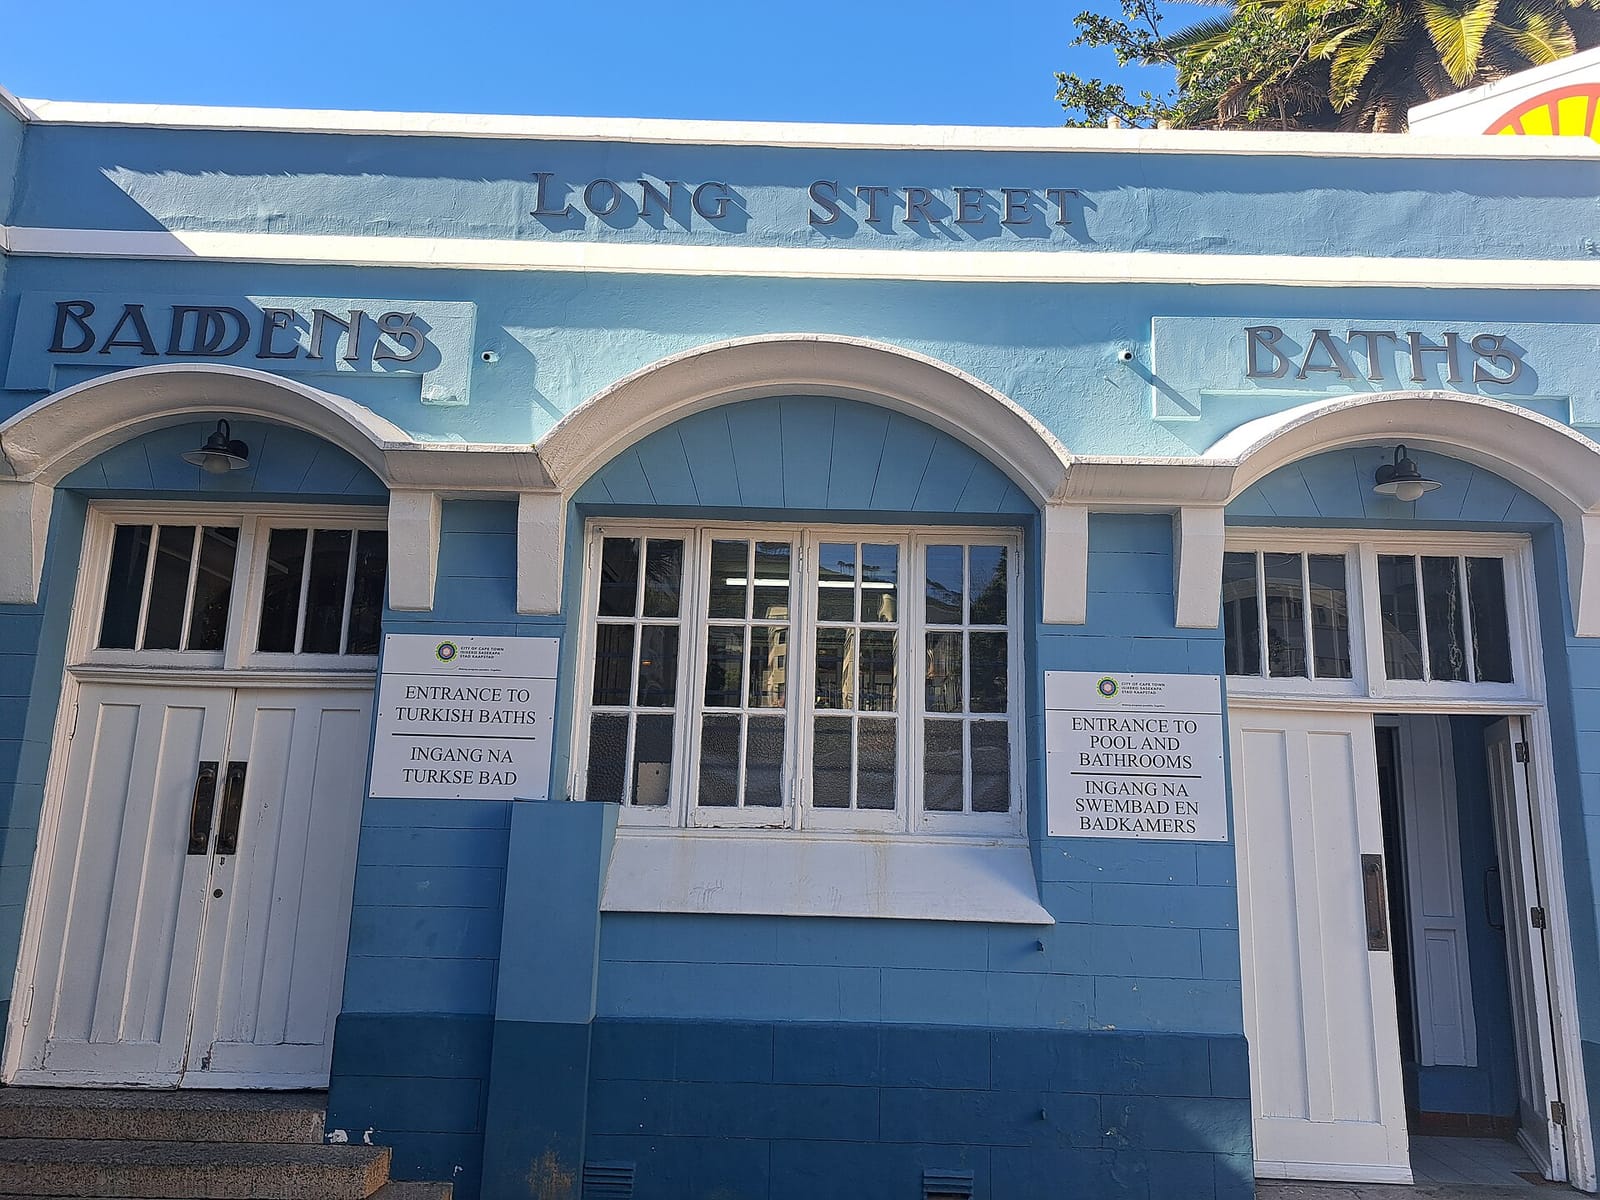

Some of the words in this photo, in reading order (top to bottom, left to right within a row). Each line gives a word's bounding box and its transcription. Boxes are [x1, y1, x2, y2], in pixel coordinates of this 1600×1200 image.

[530, 172, 732, 219] LONG
[807, 180, 1082, 225] STREET
[47, 300, 425, 361] BADDENS
[1244, 326, 1522, 385] BATHS
[405, 685, 502, 702] ENTRANCE
[506, 688, 530, 703] TO
[395, 706, 474, 723] TURKISH
[478, 709, 536, 725] BATHS
[1072, 717, 1169, 733] ENTRANCE
[1172, 719, 1198, 734] TO
[1090, 735, 1138, 750] POOL
[1140, 736, 1180, 751] AND
[410, 746, 483, 763] INGANG
[487, 748, 514, 764] NA
[1079, 752, 1193, 769] BATHROOMS
[402, 768, 474, 785] TURKSE
[478, 770, 518, 786] BAD
[1085, 780, 1157, 797] INGANG
[1162, 782, 1189, 797] NA
[1075, 797, 1170, 815] SWEMBAD
[1175, 801, 1199, 815] EN
[1079, 816, 1196, 834] BADKAMERS
